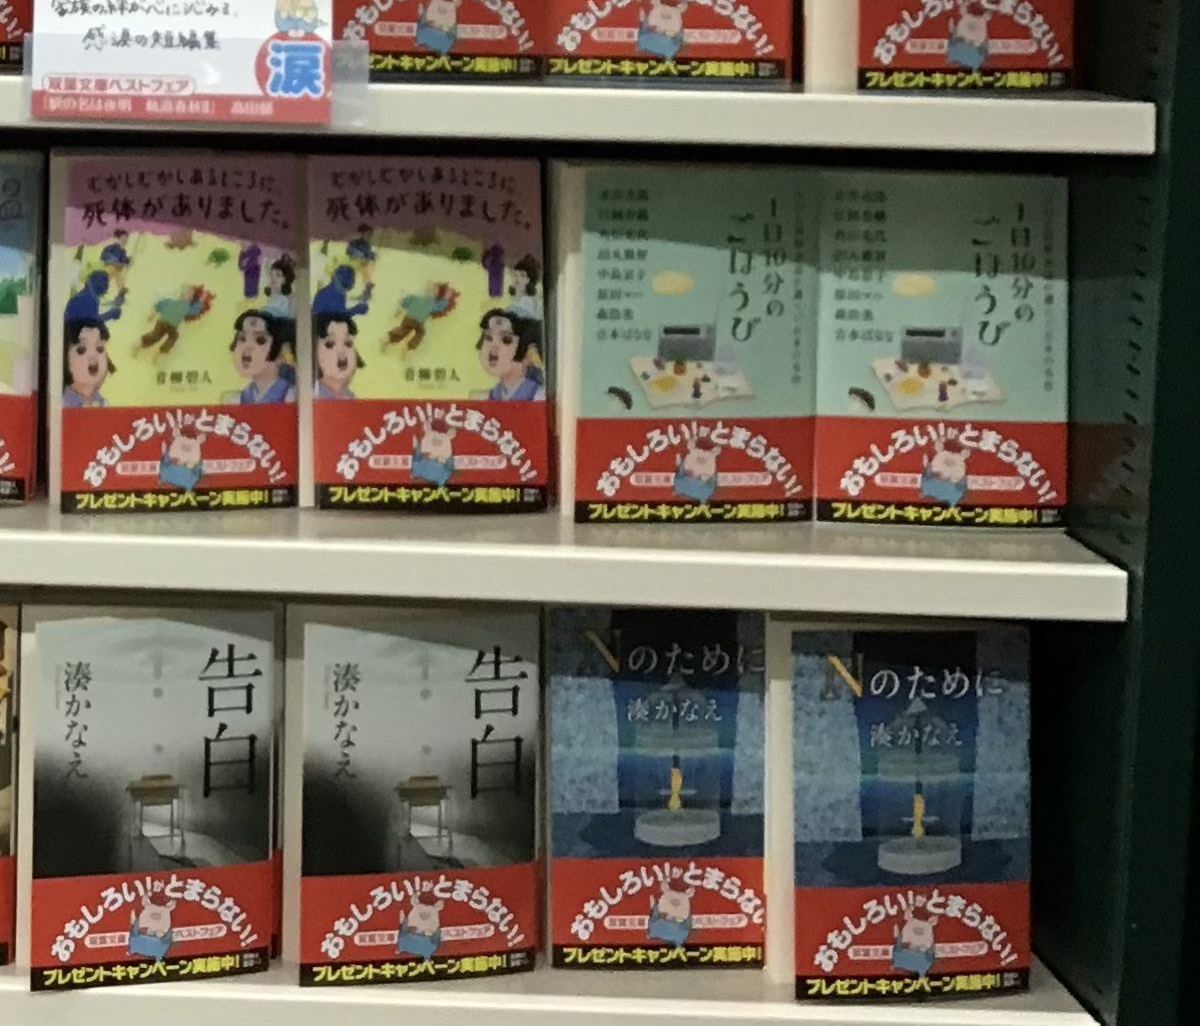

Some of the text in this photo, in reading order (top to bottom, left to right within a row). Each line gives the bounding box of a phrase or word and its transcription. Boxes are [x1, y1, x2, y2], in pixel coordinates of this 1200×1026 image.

[269, 42, 323, 95] 涙
[63, 661, 93, 779] 湊かなえ
[198, 643, 263, 798] 告白
[333, 662, 363, 779] 湊かなえ
[464, 645, 529, 799] 告白
